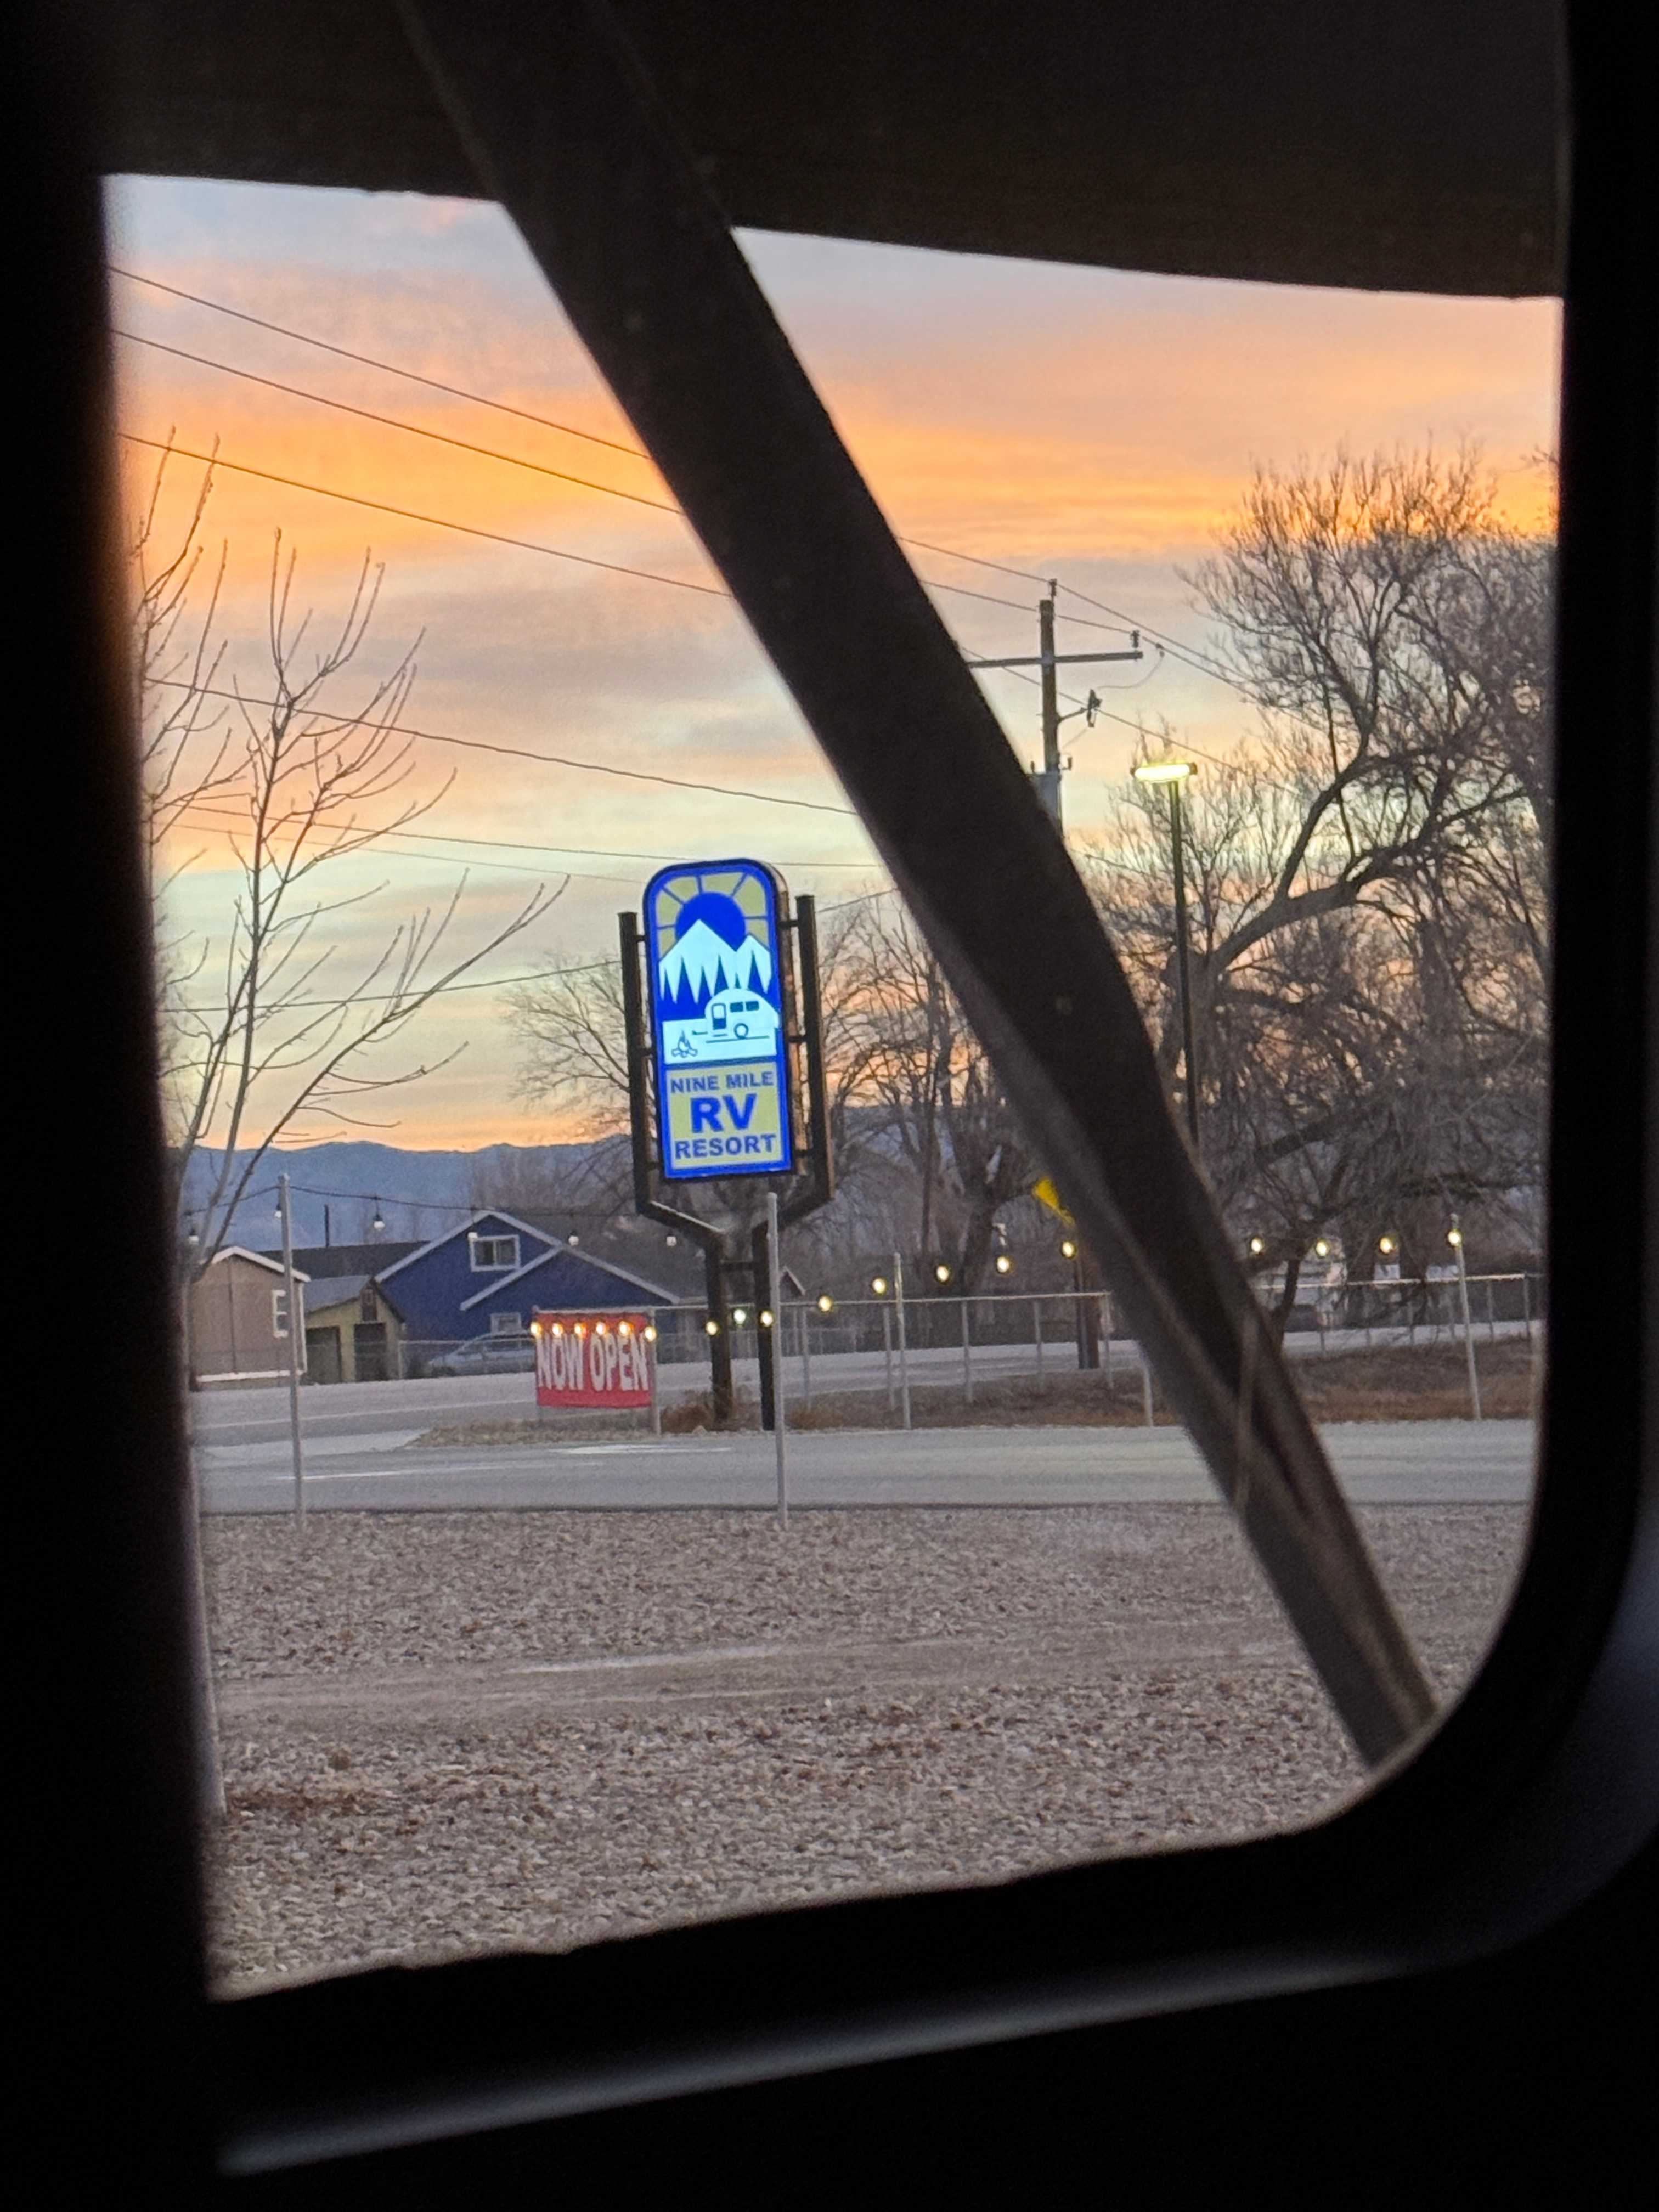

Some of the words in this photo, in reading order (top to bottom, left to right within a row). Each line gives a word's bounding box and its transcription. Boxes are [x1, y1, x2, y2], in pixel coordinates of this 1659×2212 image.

[671, 1075, 719, 1093] NINE
[725, 1071, 774, 1088] MILE
[690, 1093, 757, 1133] RV
[675, 1134, 776, 1159] RESORT
[536, 1333, 584, 1391] NOW
[590, 1332, 649, 1391] OPEN
